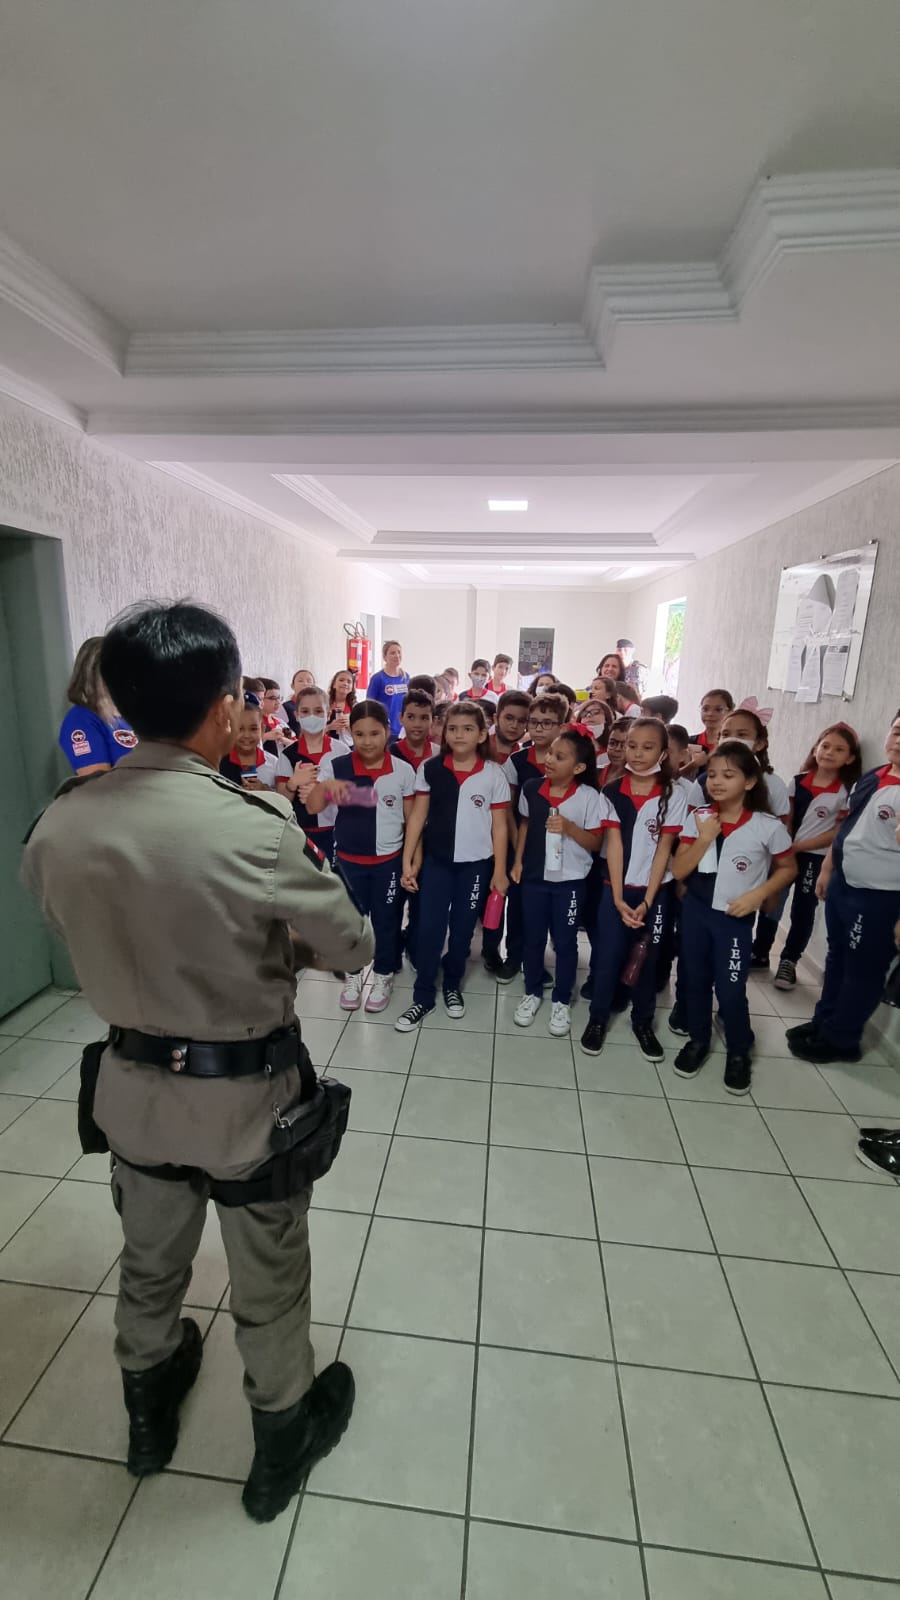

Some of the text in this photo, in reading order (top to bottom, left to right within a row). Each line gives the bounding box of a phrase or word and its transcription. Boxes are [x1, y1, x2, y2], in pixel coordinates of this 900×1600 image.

[386, 872, 396, 904] IEMS
[470, 874, 480, 909] IEMS
[567, 890, 578, 926] IEMS
[652, 904, 664, 944] IEMS
[728, 938, 741, 982] IEMS
